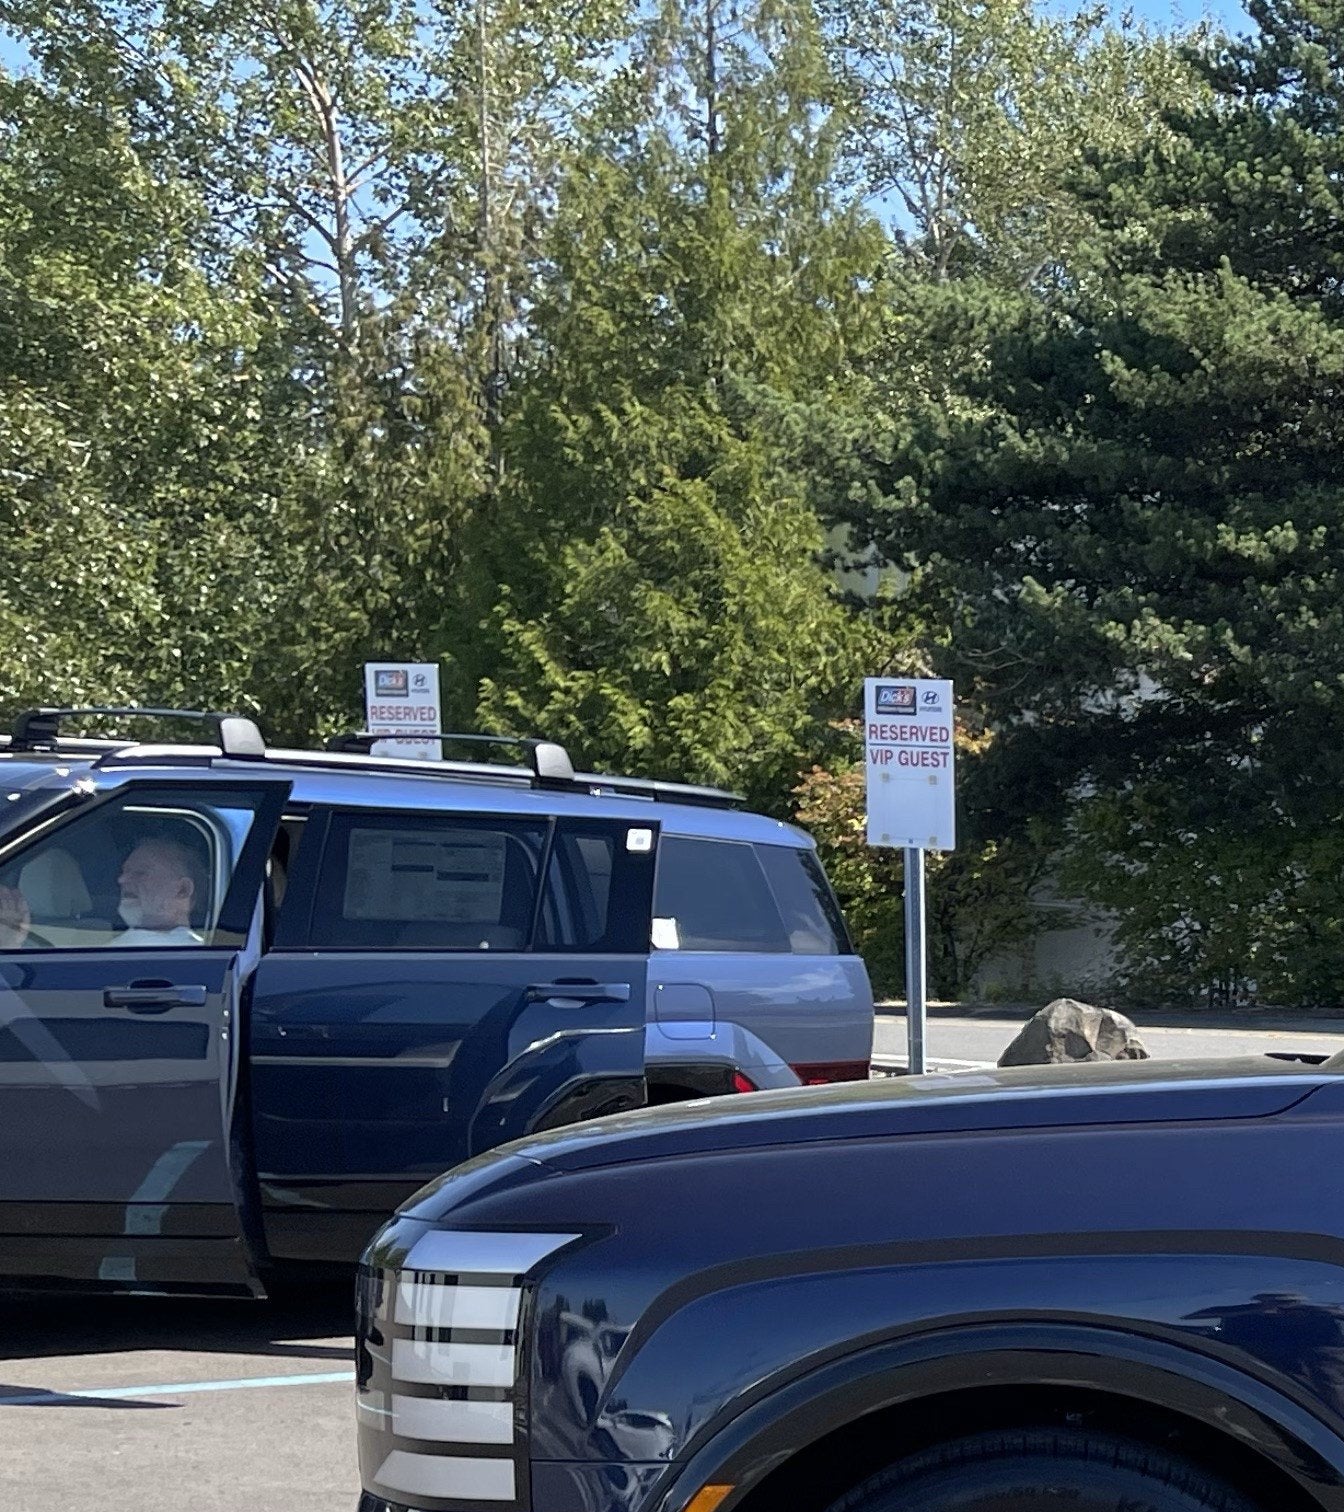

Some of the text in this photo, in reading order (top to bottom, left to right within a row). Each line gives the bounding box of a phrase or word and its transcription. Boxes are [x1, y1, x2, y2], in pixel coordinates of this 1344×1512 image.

[369, 705, 437, 722] RESERVED
[868, 723, 950, 743] RESERVED
[870, 748, 950, 769] VIP GUEST
